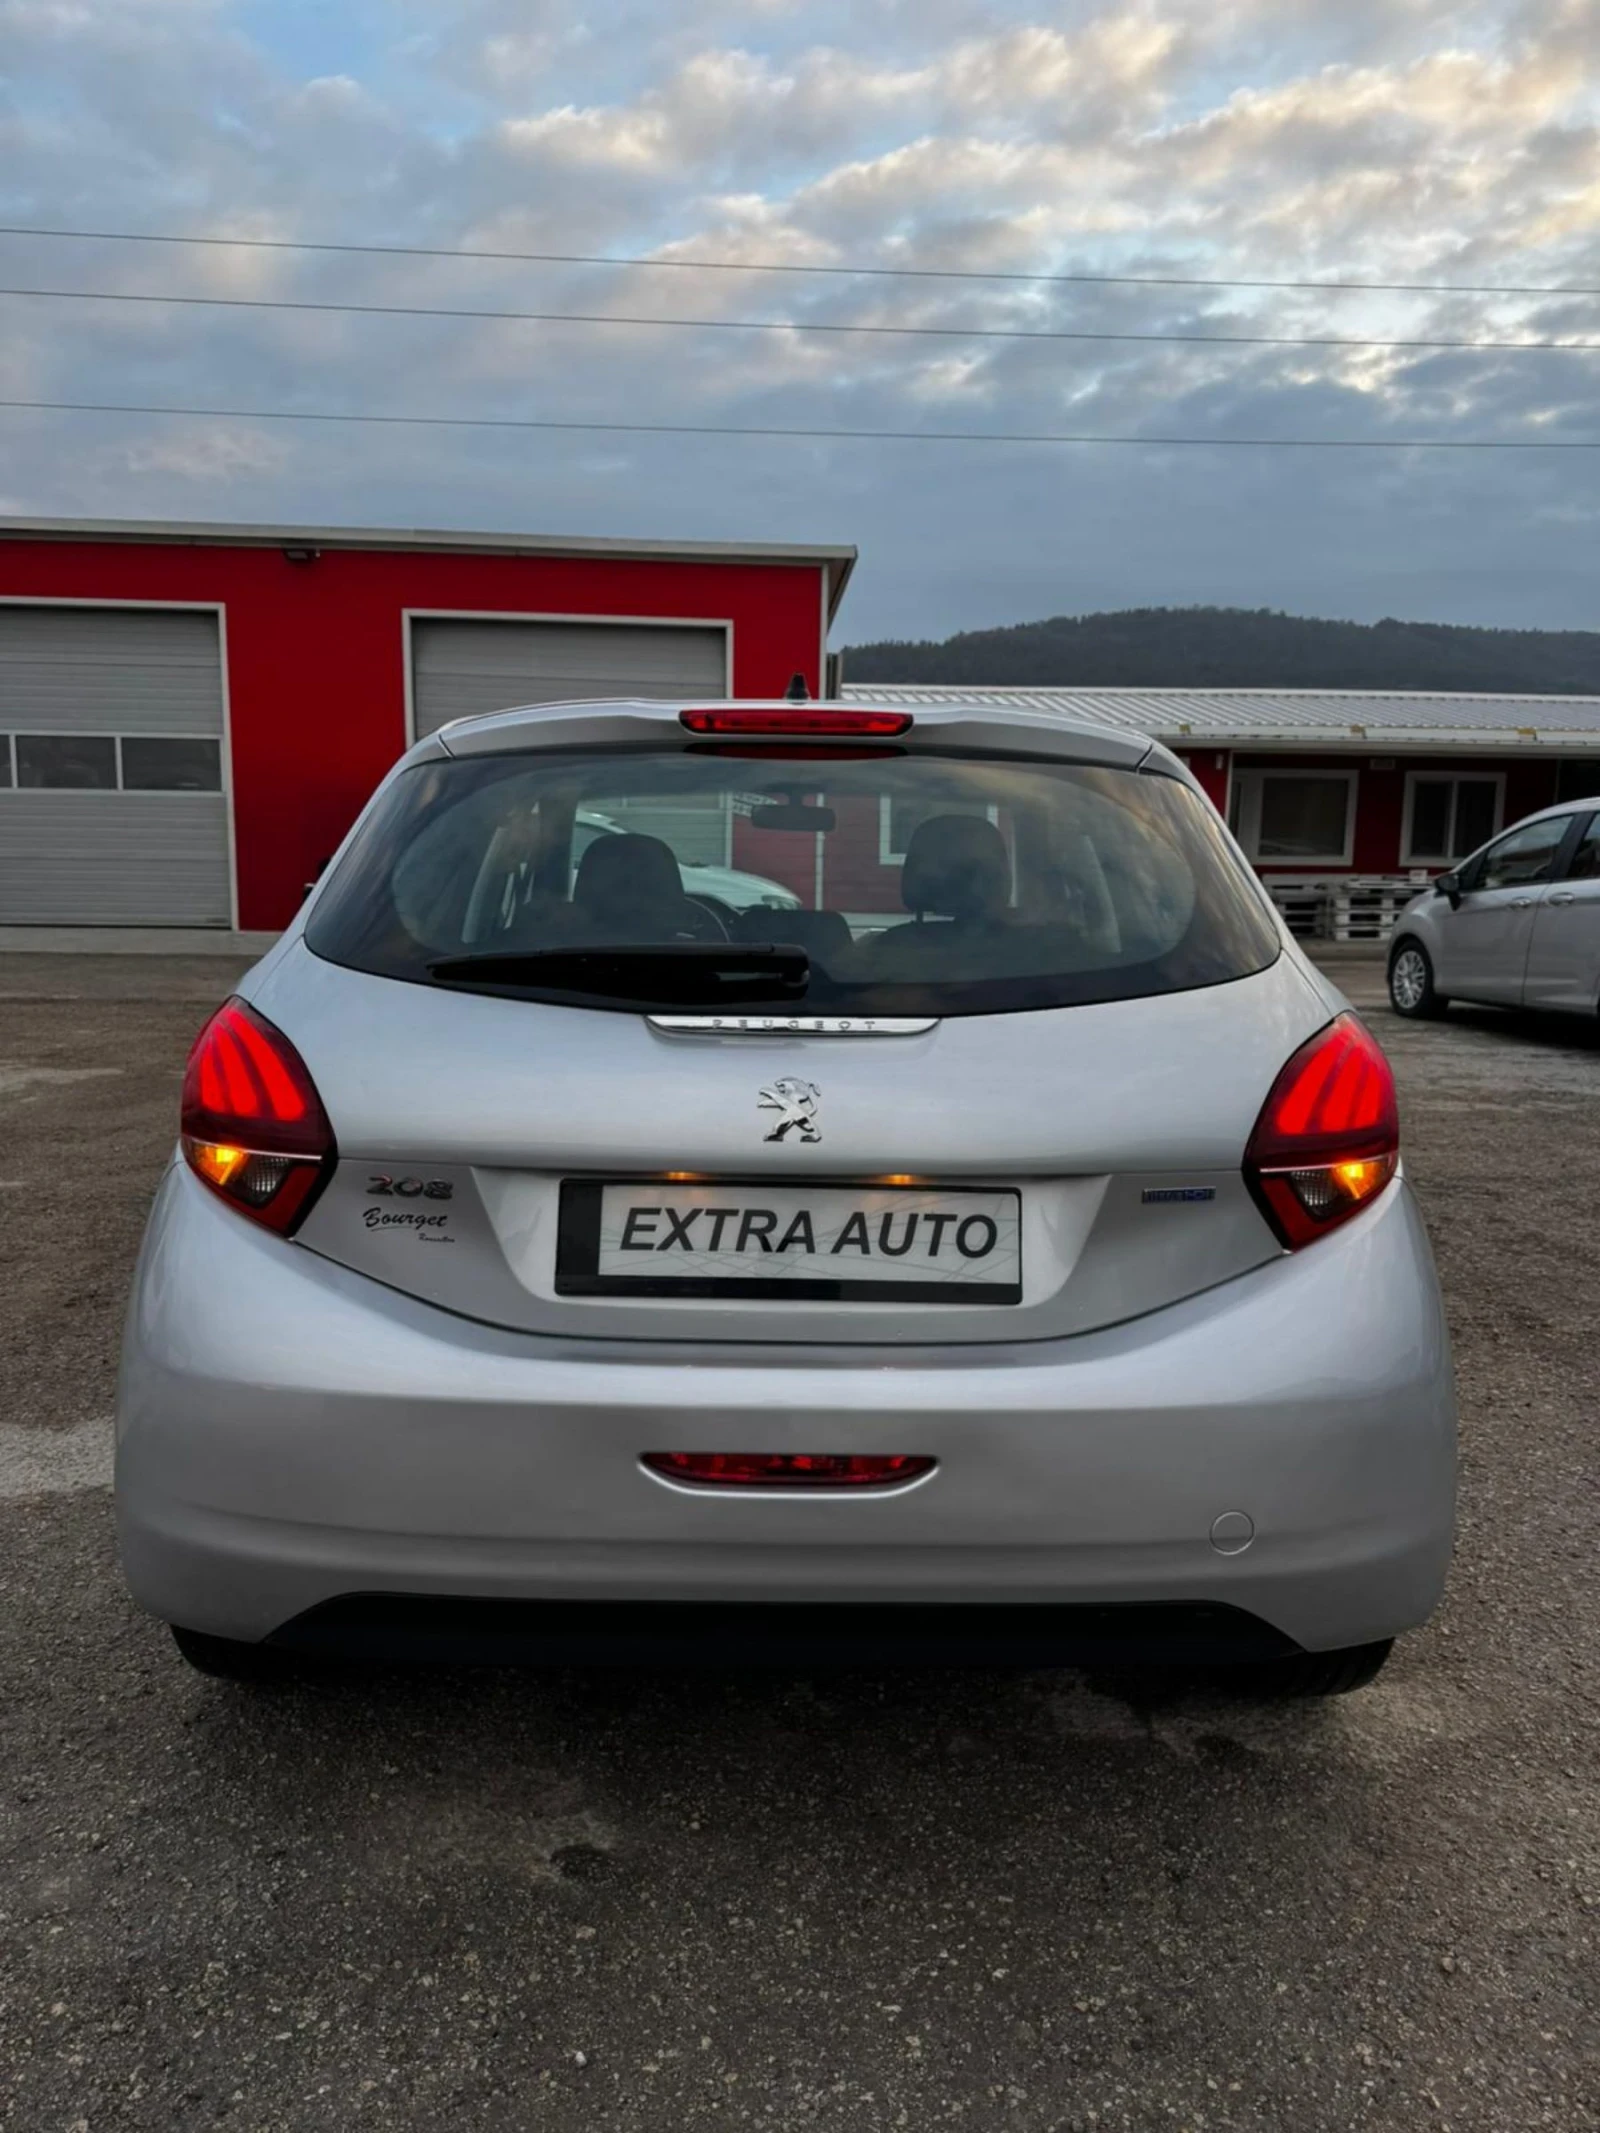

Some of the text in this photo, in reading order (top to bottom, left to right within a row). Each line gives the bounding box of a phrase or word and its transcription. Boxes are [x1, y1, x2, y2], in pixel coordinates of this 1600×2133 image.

[711, 1018, 876, 1031] PEUGEOT
[366, 1175, 453, 1200] 208
[362, 1207, 448, 1230] Bourget
[619, 1207, 998, 1259] EXTRA AUTO
